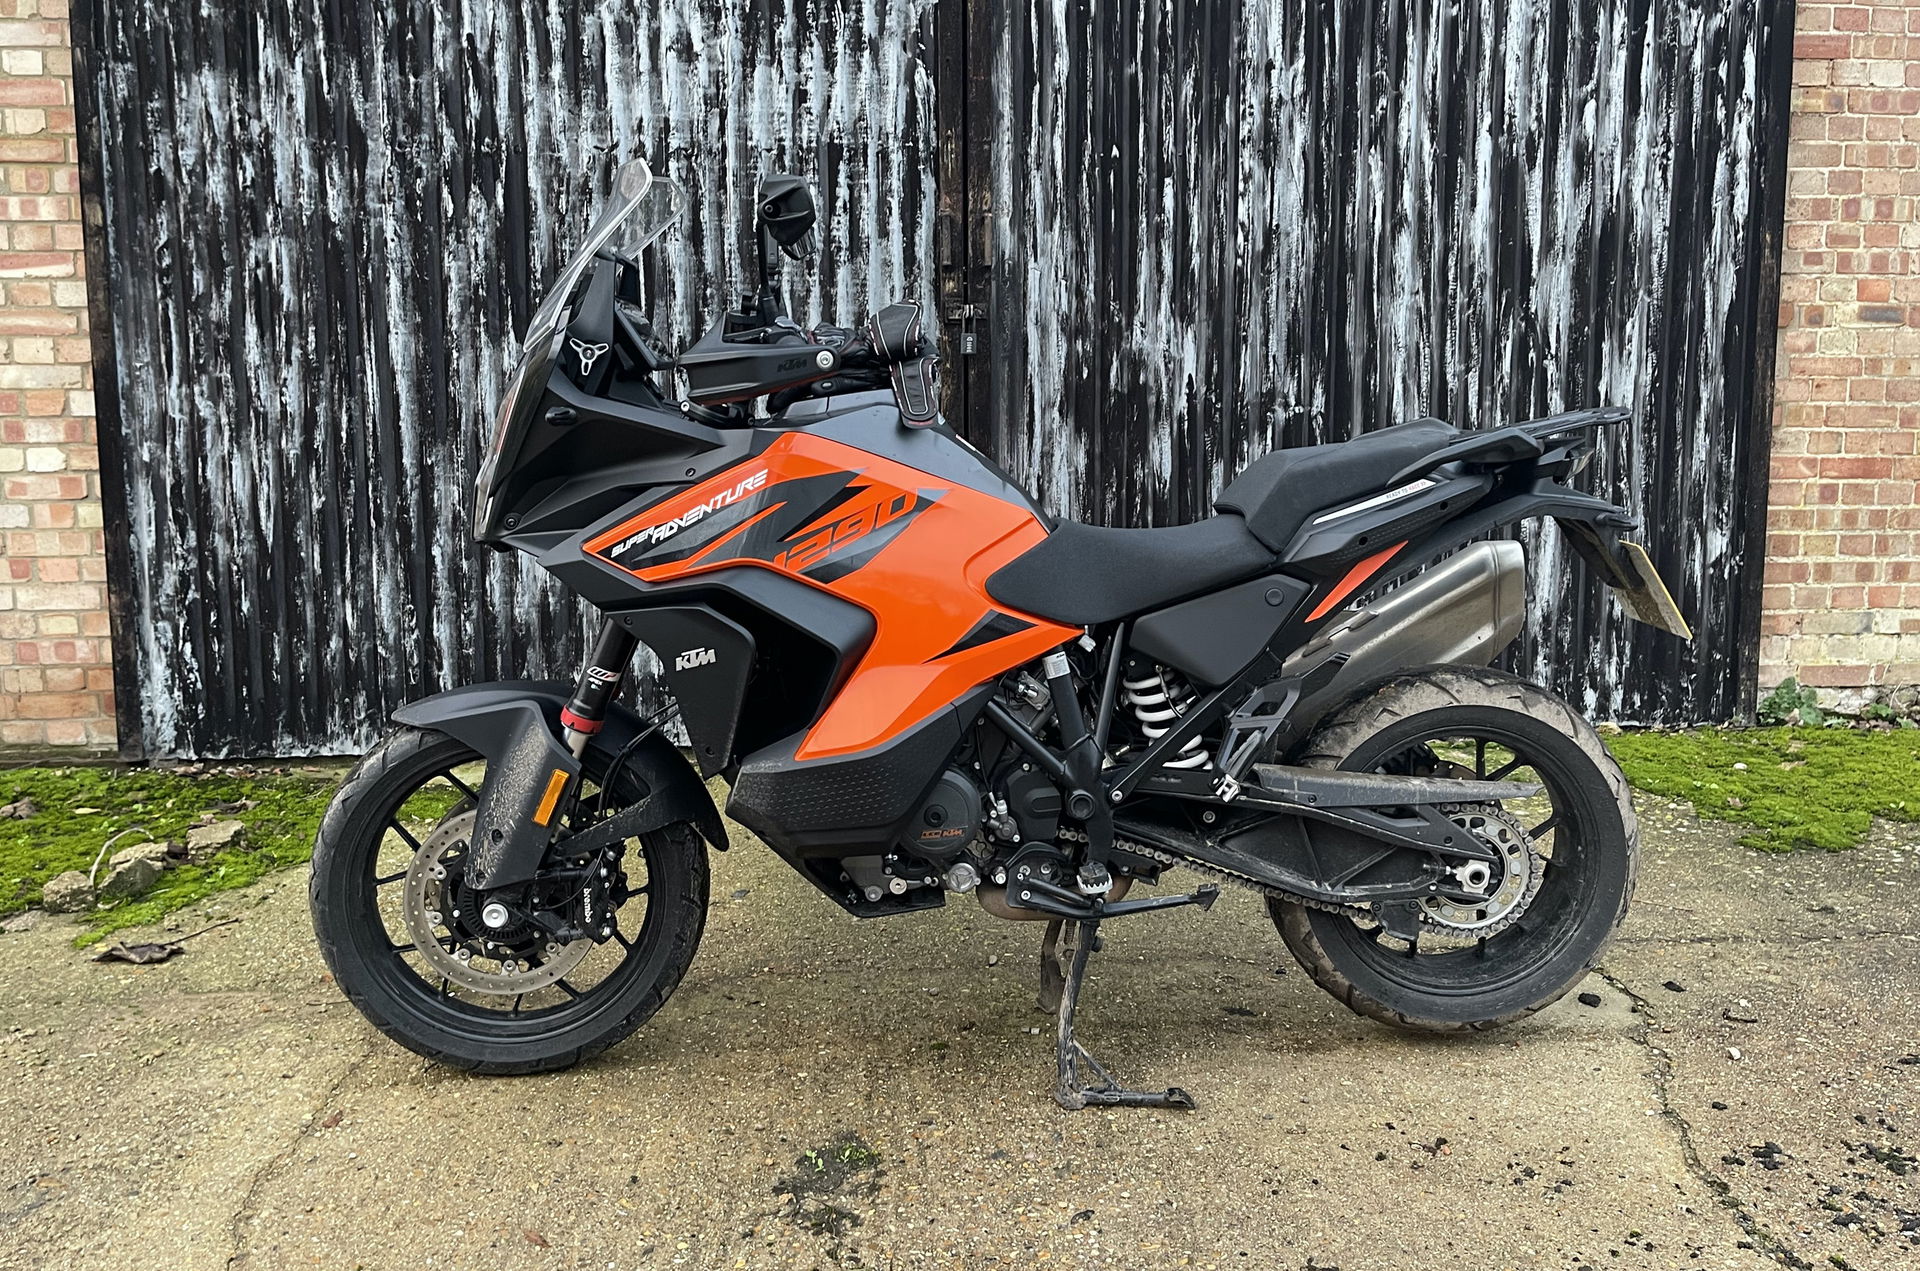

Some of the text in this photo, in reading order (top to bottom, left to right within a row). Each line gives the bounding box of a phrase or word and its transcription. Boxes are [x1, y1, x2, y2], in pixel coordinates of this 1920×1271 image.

[777, 359, 807, 372] KTM
[611, 468, 768, 557] SUPER ADVENTURE
[774, 489, 917, 573] 1290
[675, 647, 716, 671] KTM
[583, 888, 593, 923] brembo
